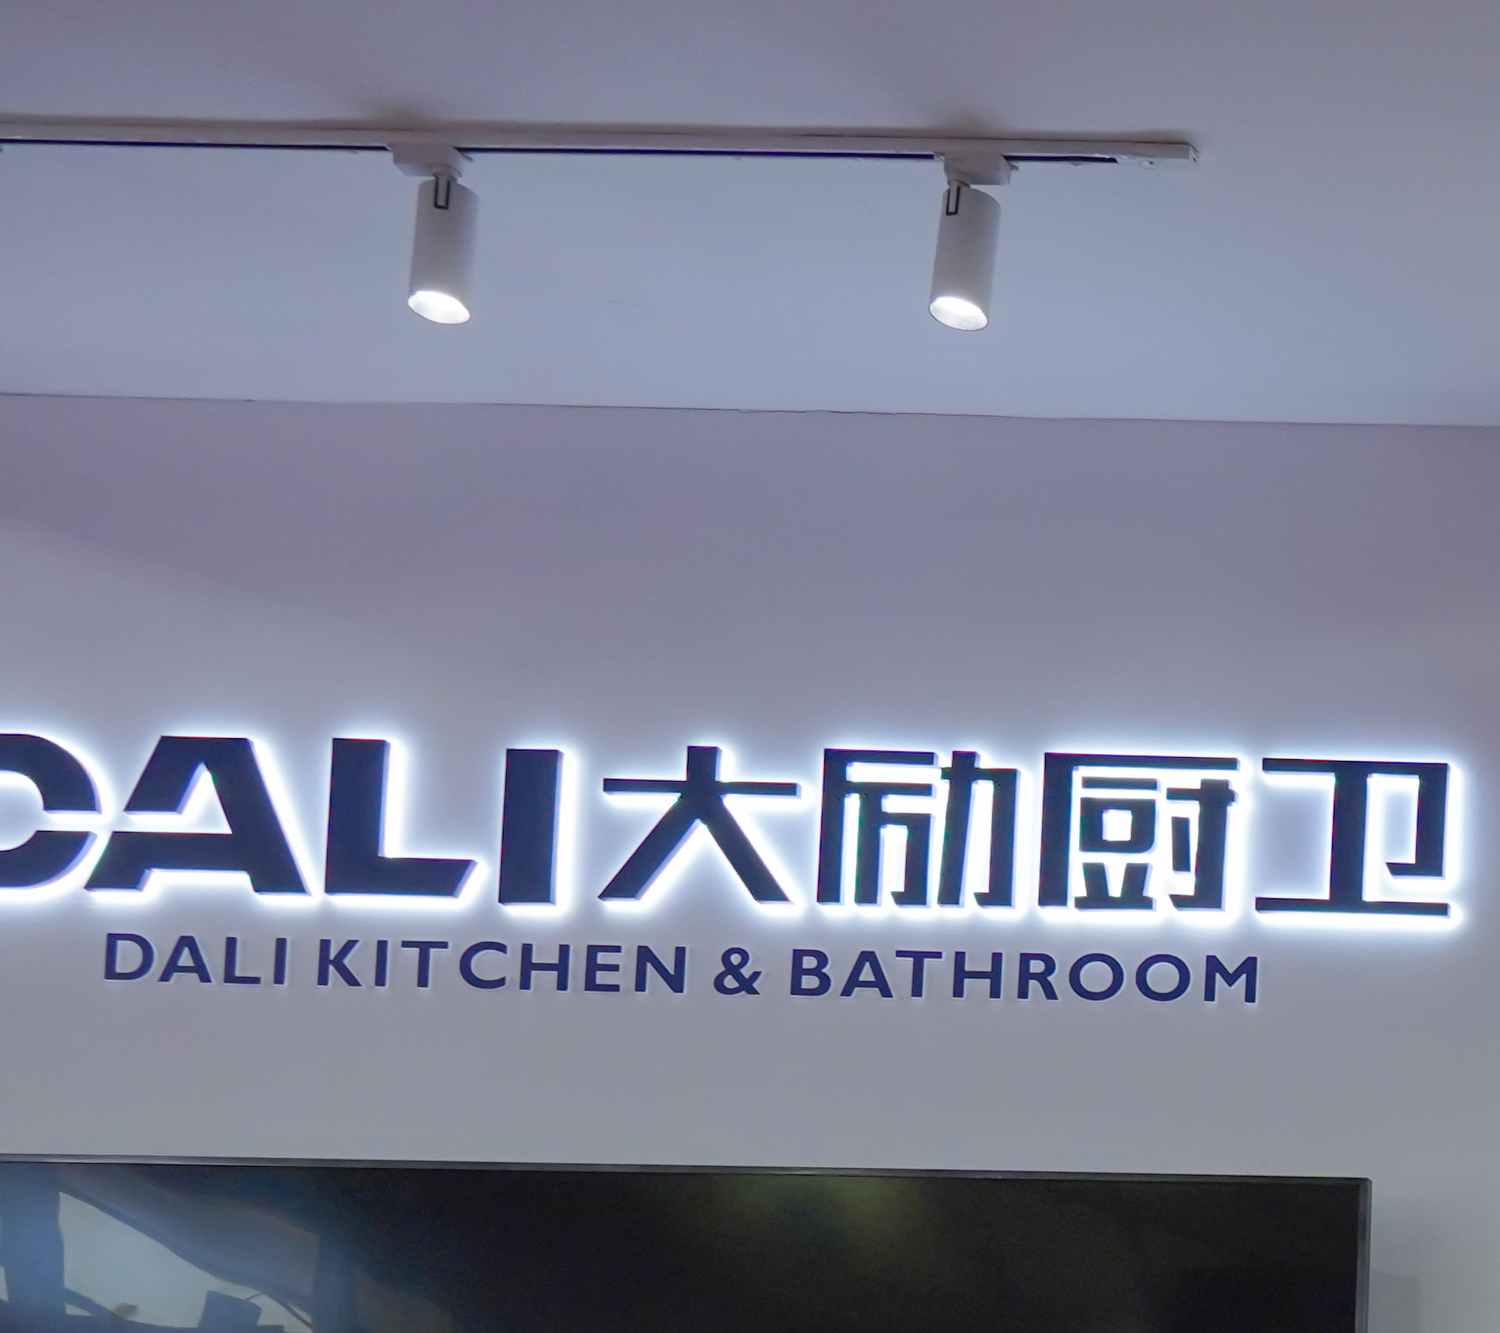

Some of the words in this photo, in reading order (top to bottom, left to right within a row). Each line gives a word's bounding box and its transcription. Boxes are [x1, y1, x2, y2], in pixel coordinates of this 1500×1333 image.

[600, 746, 1450, 915] 大励厨卫
[103, 931, 288, 986] DALI
[315, 936, 688, 995] KITCHEN
[711, 946, 761, 998] &
[789, 949, 1261, 1005] BATHROOM
